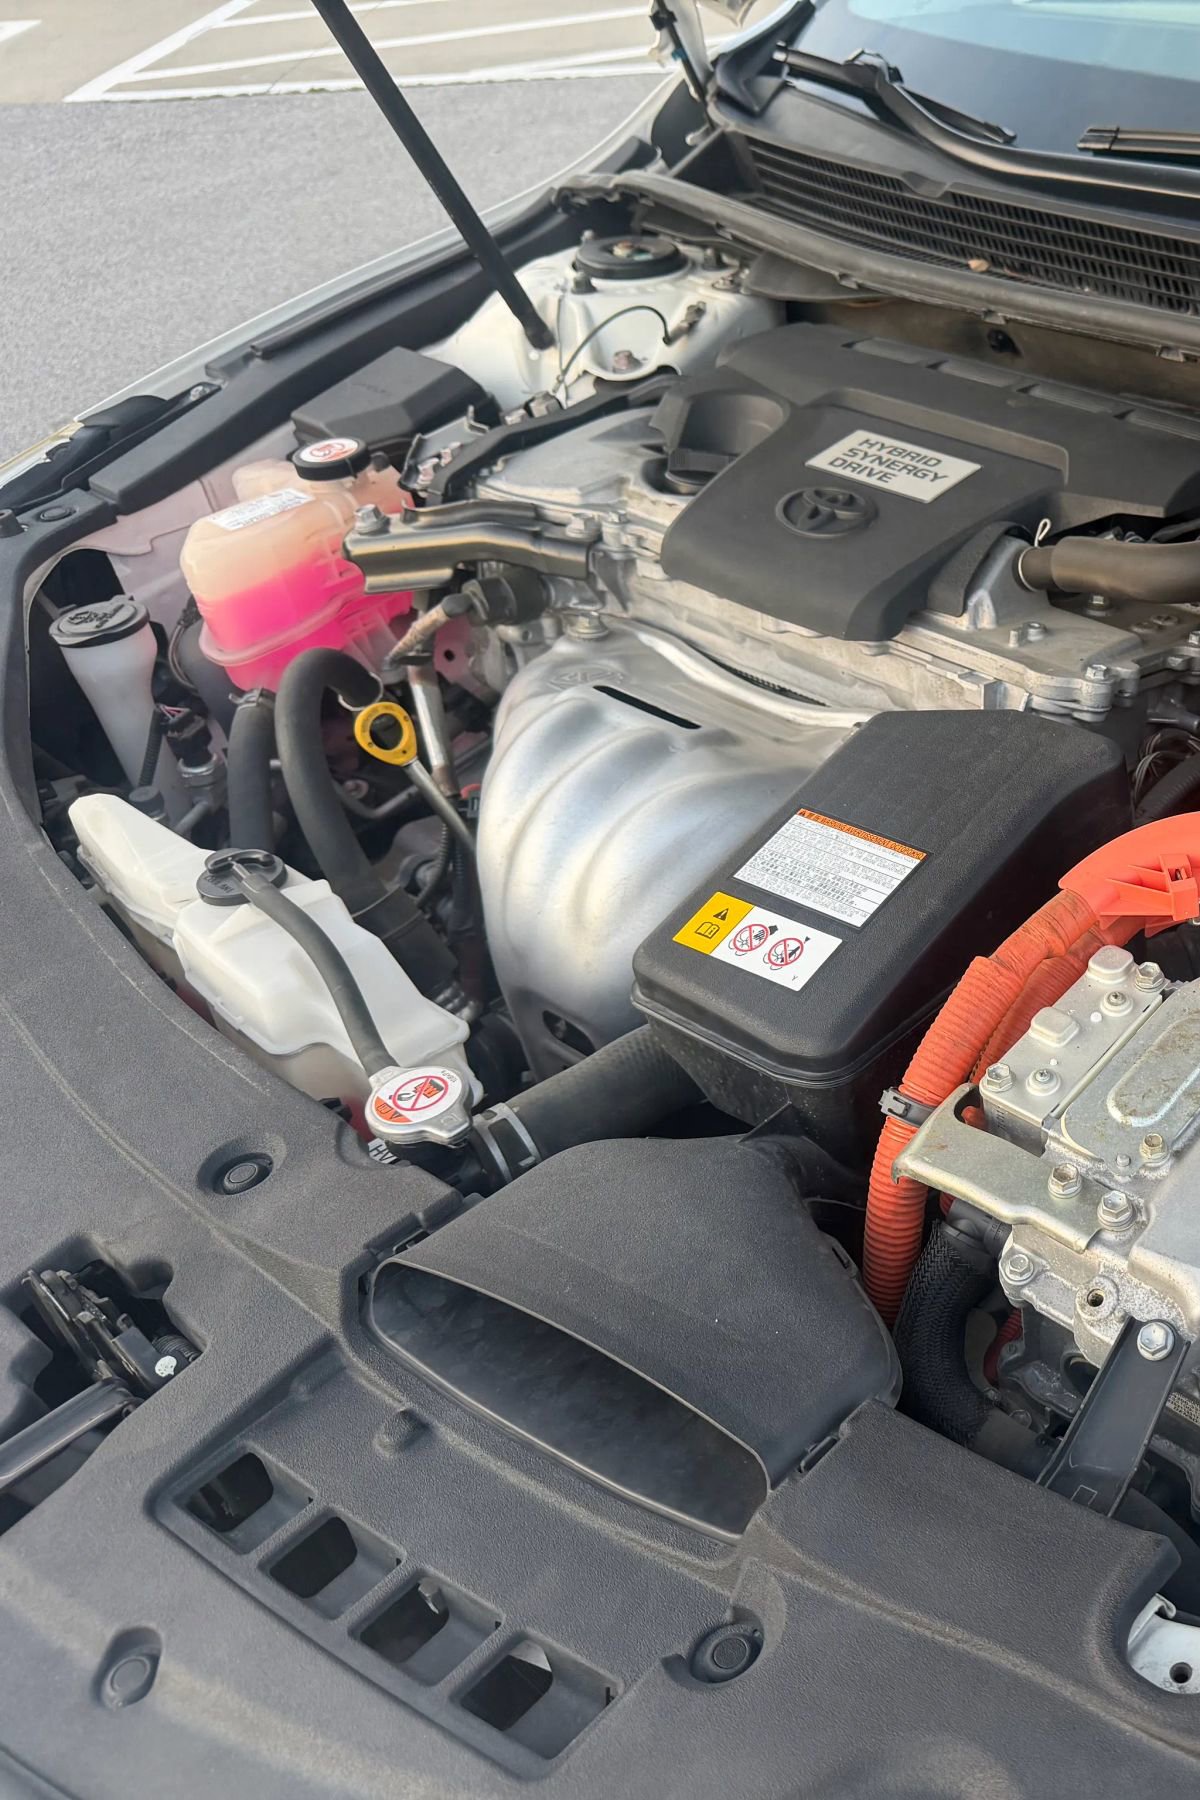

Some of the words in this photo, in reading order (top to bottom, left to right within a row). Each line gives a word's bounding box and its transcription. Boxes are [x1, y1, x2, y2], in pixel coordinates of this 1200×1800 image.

[842, 447, 949, 483] SYNERGY
[858, 438, 943, 468] HYBRID
[828, 457, 897, 484] DRIVE
[369, 1144, 395, 1161] HV
